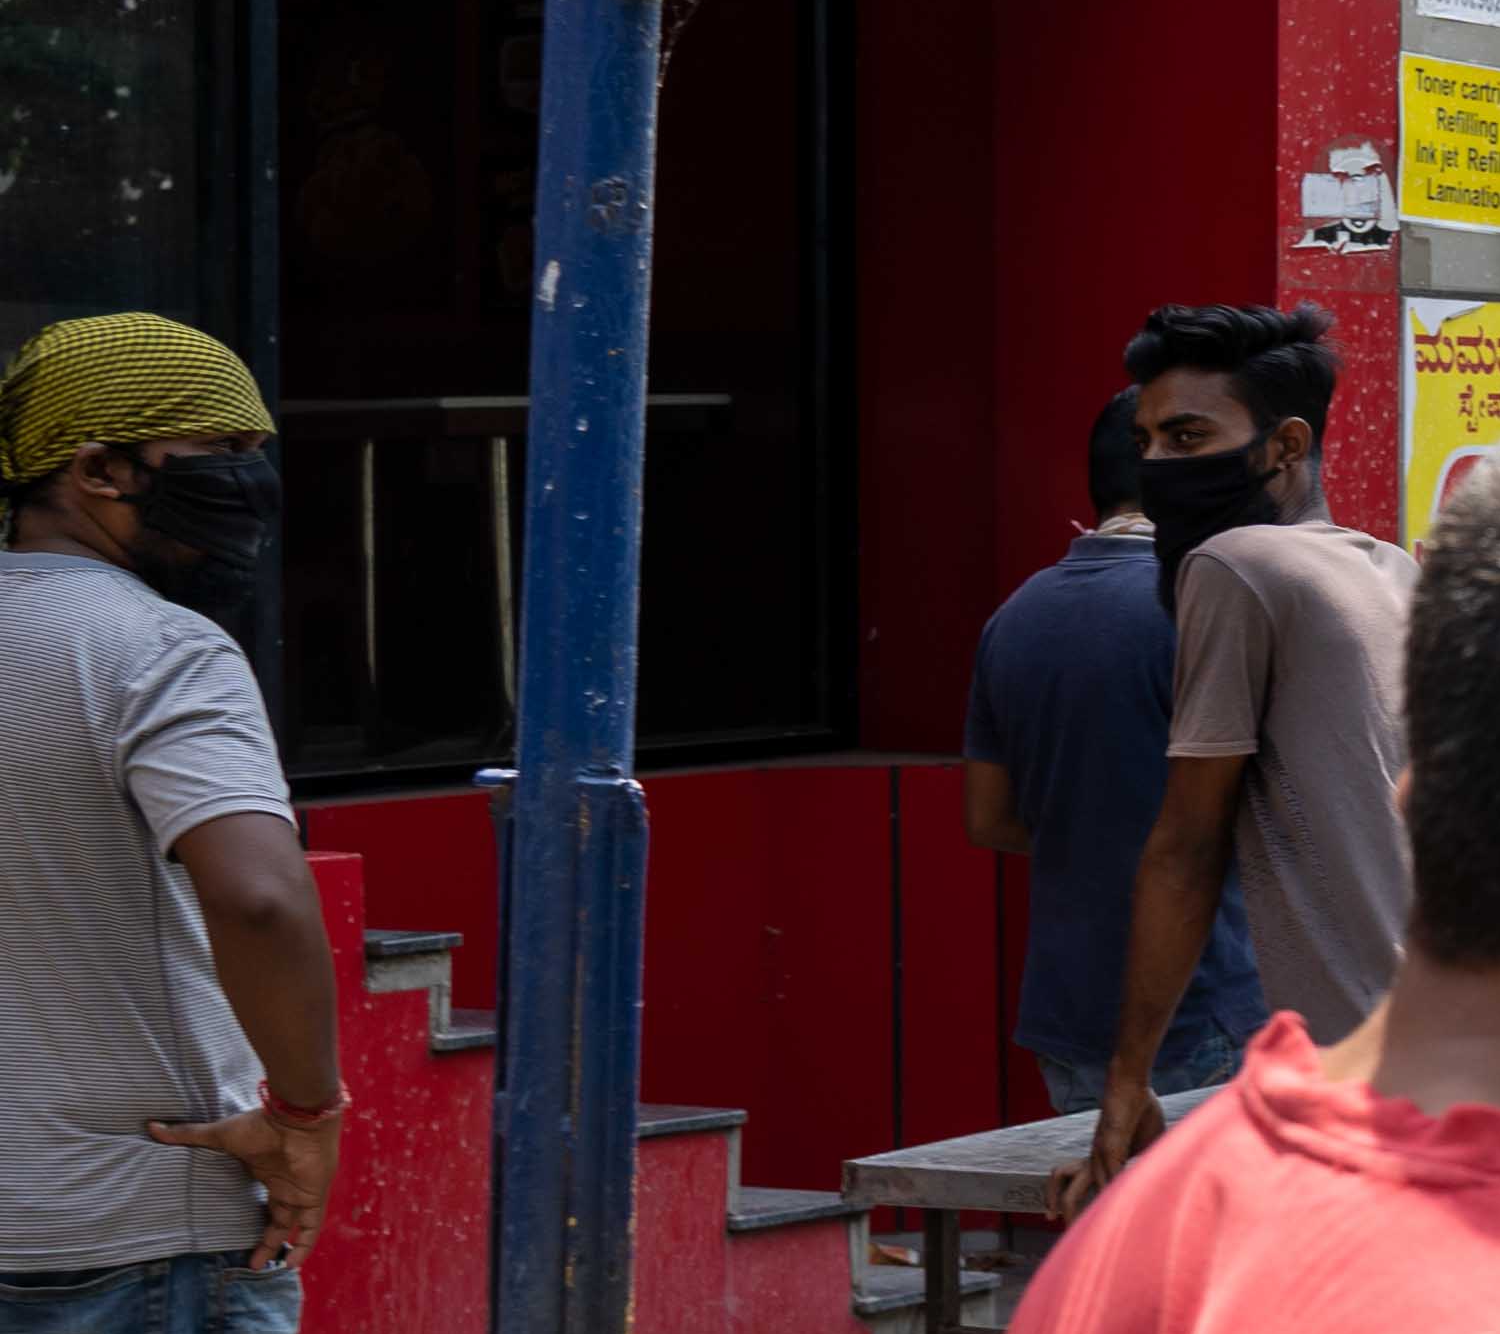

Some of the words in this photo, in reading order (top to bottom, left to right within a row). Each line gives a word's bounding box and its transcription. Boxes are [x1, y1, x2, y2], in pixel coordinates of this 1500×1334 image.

[1415, 68, 1456, 98] Toner
[1436, 107, 1499, 144] Refilling
[1416, 139, 1437, 165] Ink
[1440, 143, 1459, 172] jet
